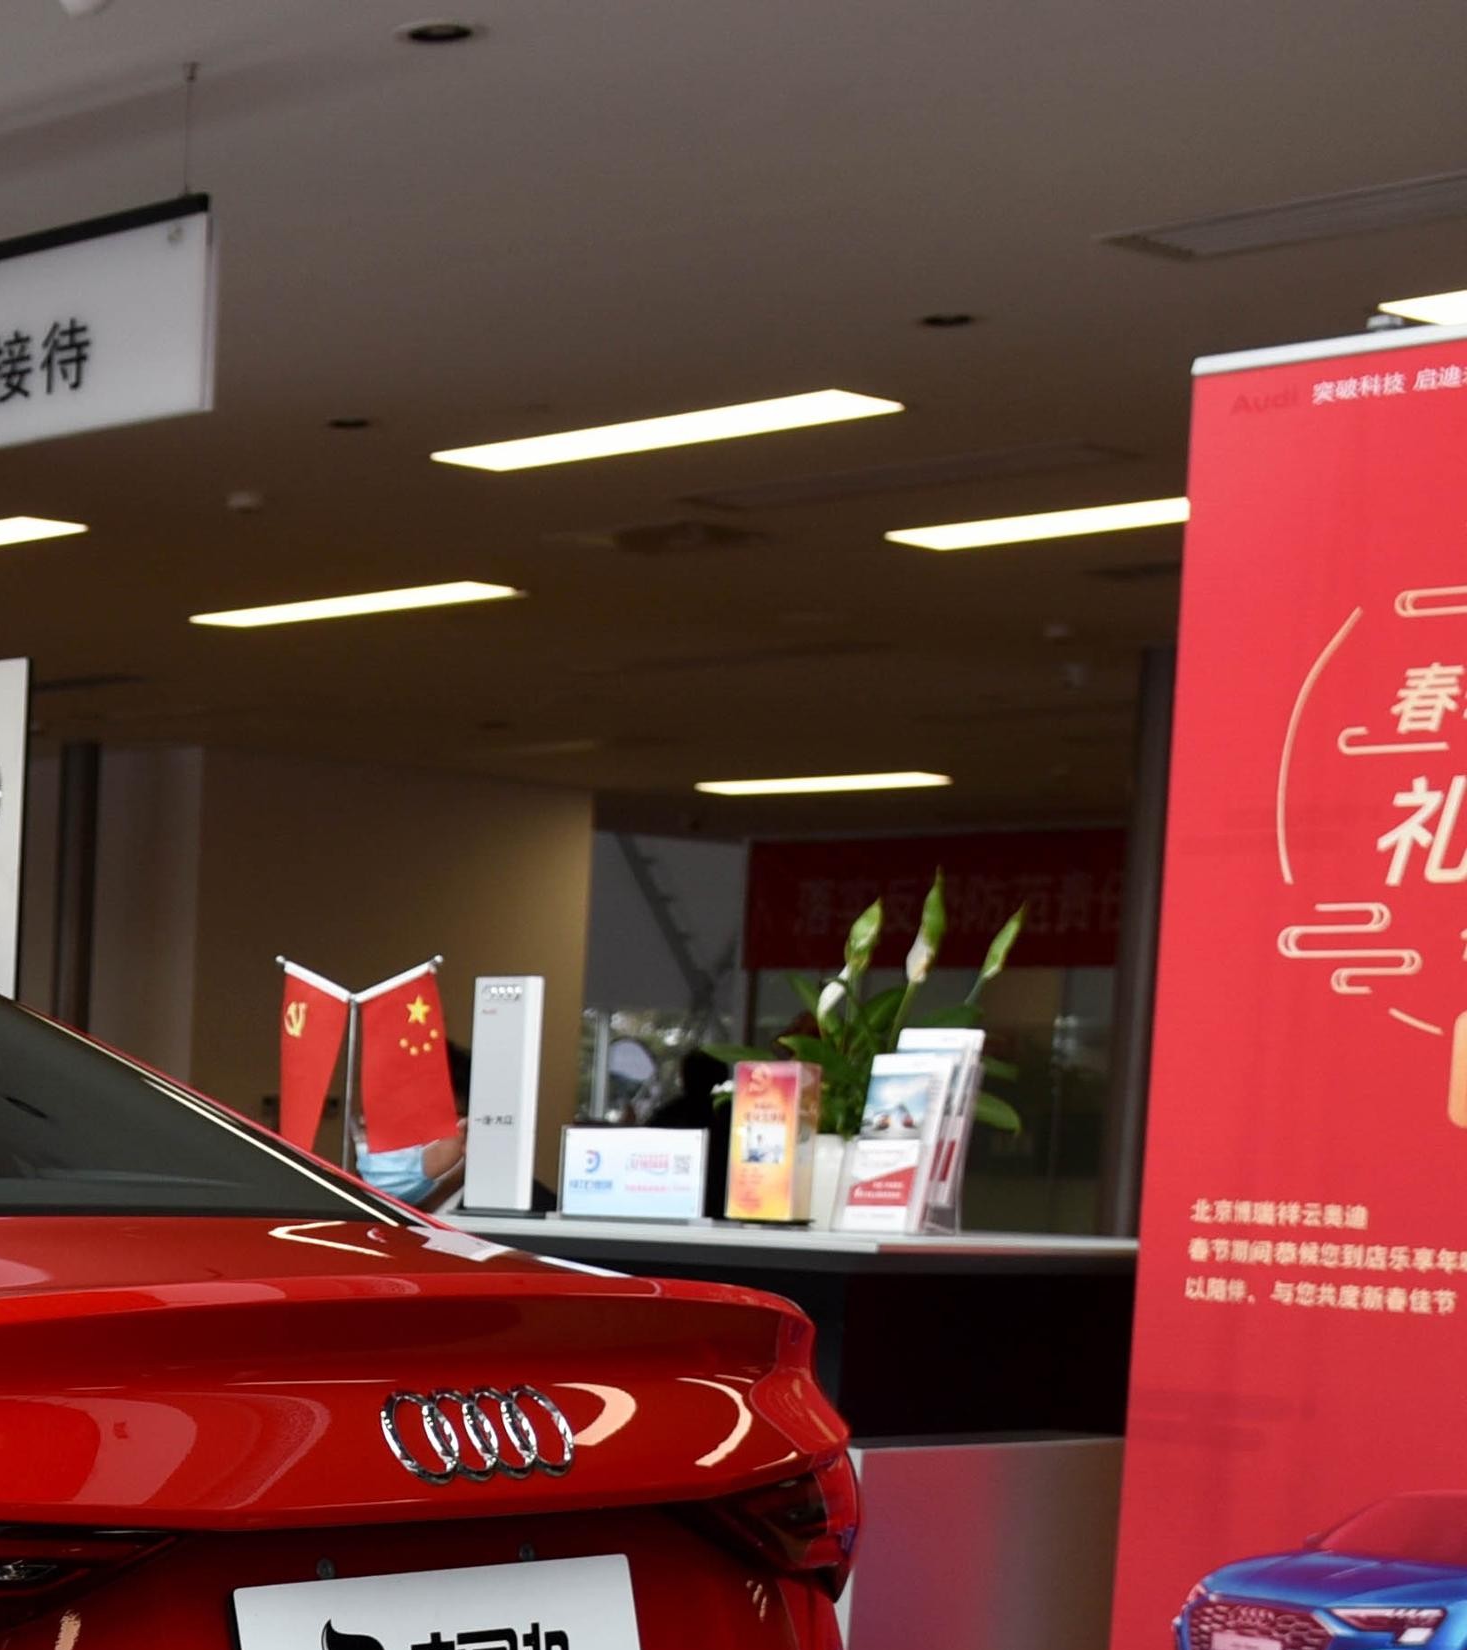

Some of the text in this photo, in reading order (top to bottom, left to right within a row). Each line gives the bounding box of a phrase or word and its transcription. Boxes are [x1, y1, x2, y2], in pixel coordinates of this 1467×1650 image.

[1412, 364, 1467, 391] 启迪
[1390, 662, 1467, 734] 春
[1190, 1198, 1369, 1231] 北京博瑞祥云奥迪
